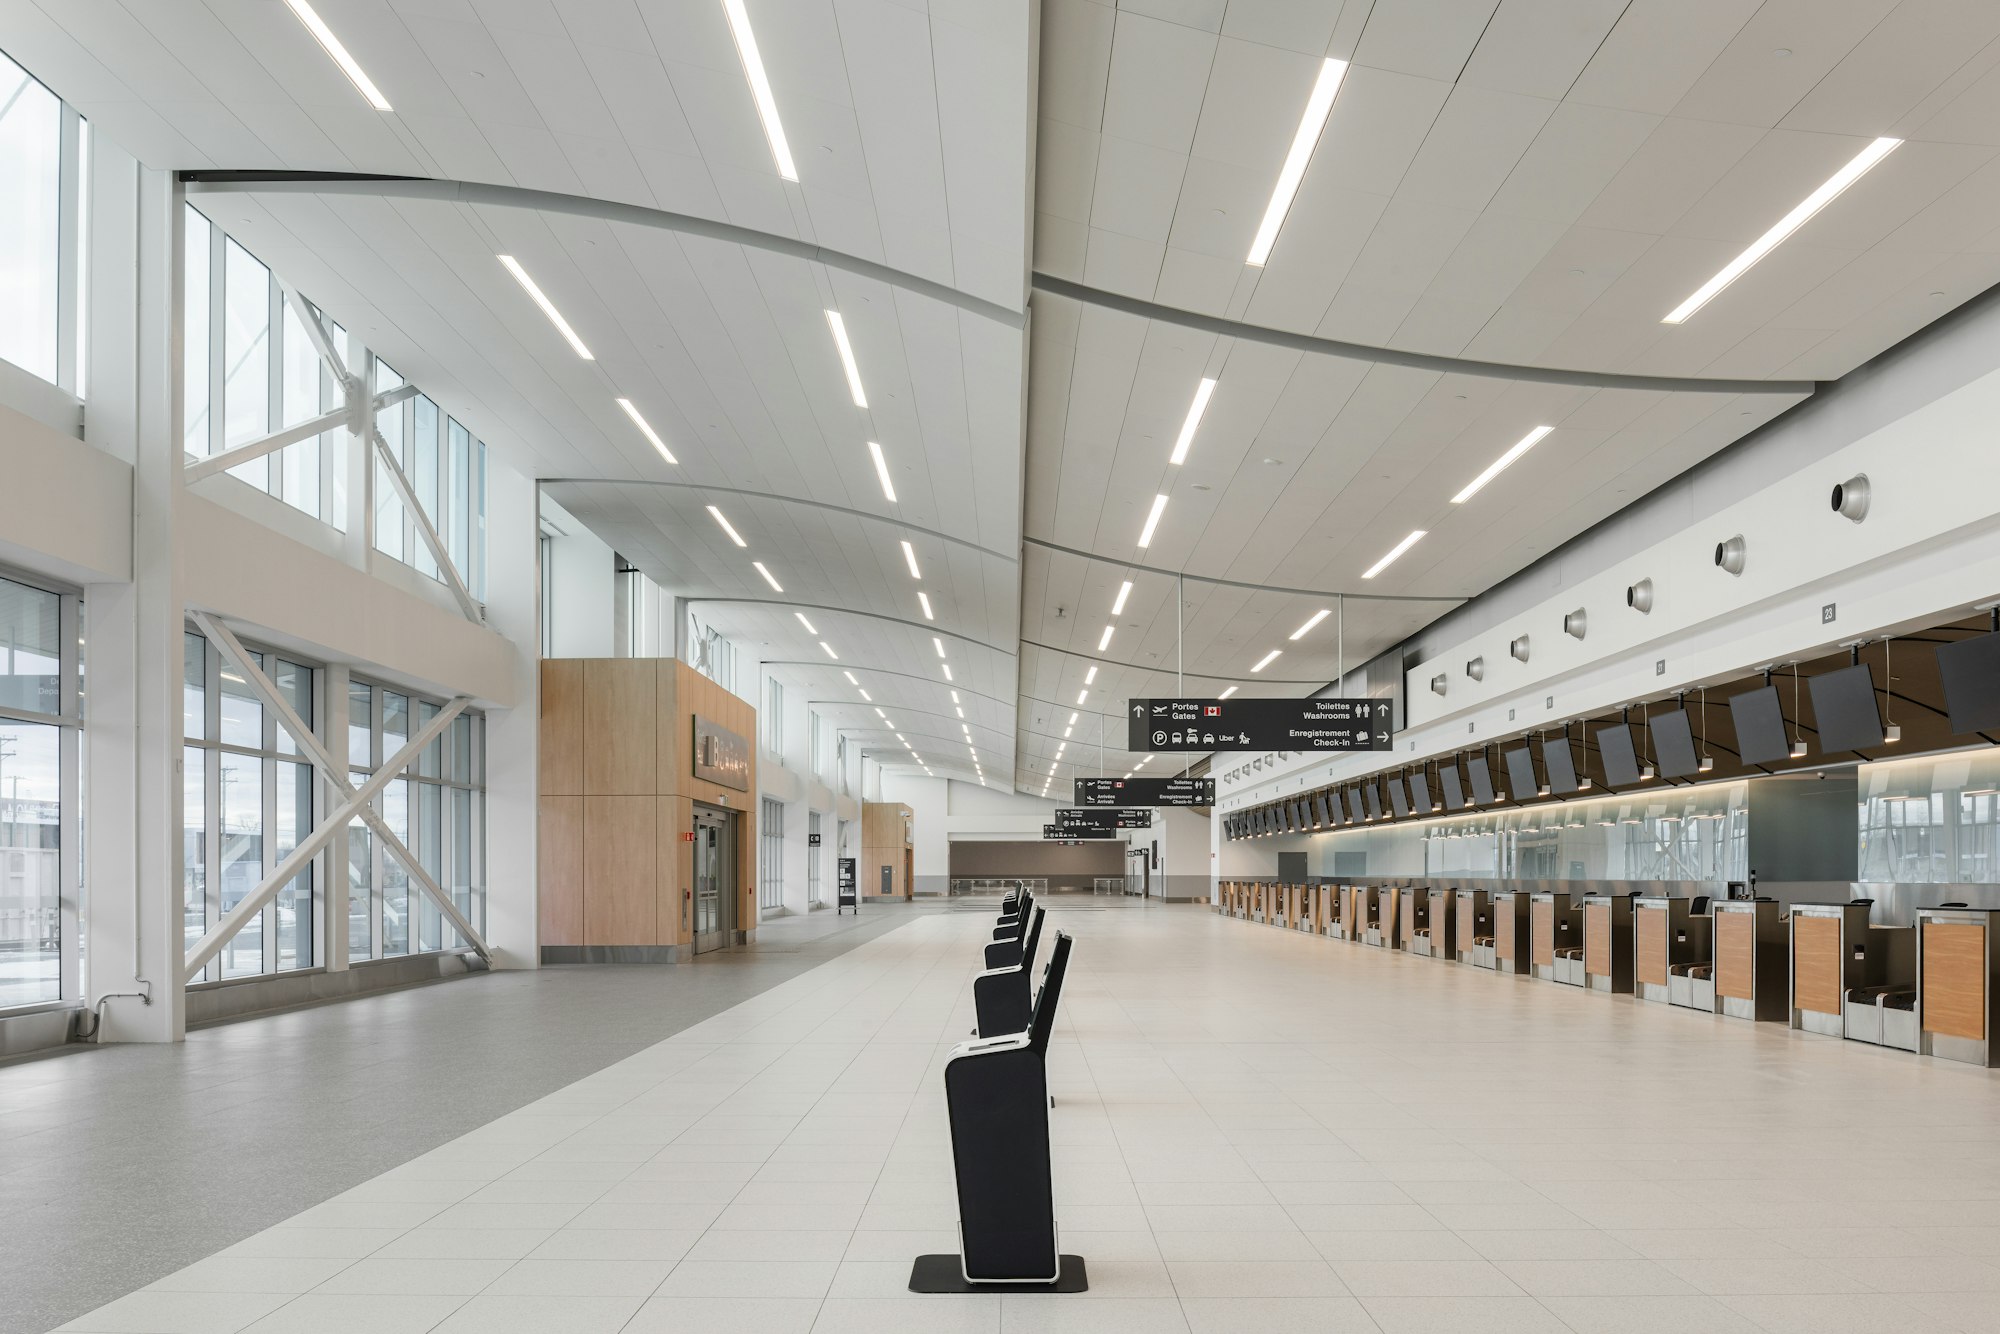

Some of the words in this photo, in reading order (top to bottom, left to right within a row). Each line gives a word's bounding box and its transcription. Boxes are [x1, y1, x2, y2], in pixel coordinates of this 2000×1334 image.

[1824, 607, 1833, 620] 23
[1172, 703, 1199, 711] Portes
[1315, 702, 1350, 710] Toilettes
[1172, 712, 1196, 720] Gates
[1303, 712, 1350, 720] Washrooms
[1289, 729, 1350, 738] Enregistrement
[1313, 738, 1350, 746] Check-In
